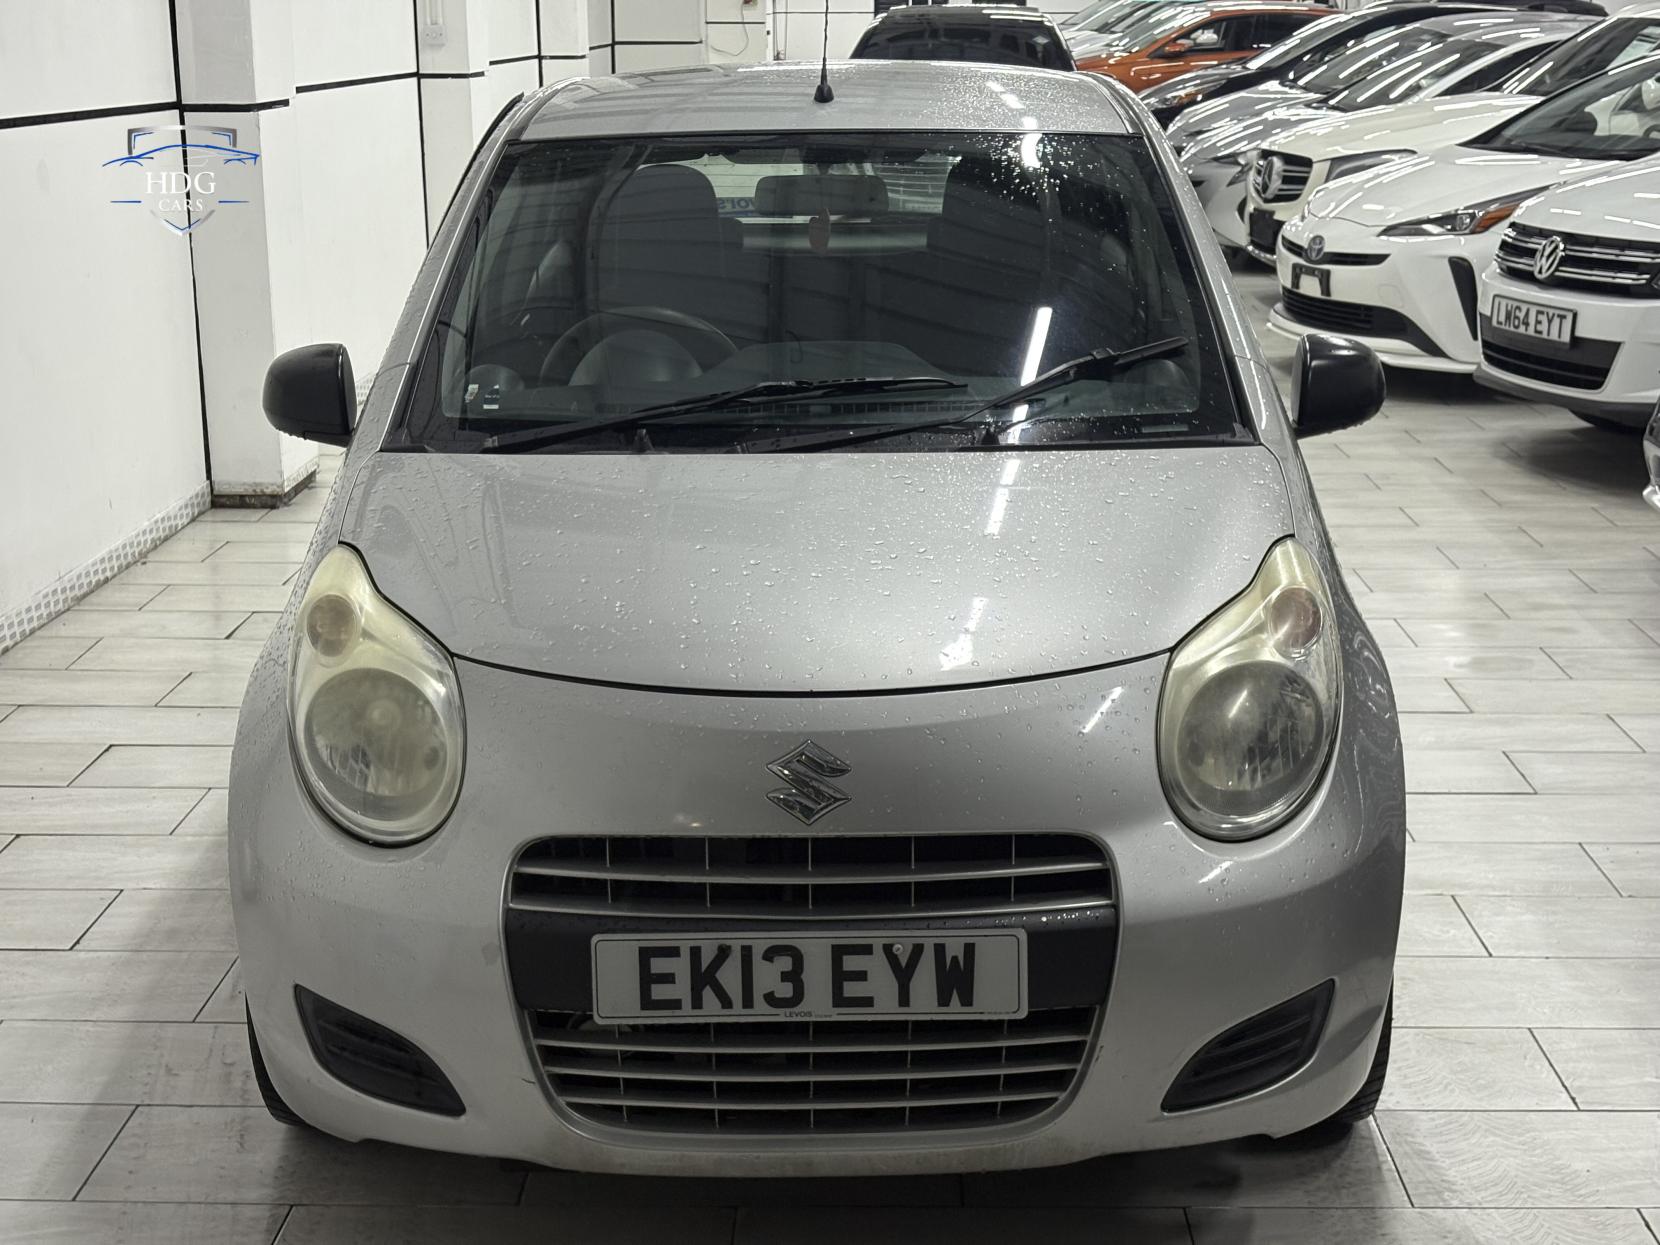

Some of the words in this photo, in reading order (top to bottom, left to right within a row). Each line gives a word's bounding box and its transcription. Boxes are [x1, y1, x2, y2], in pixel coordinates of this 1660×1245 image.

[1496, 300, 1531, 333] LW64
[1534, 308, 1568, 340] EYT
[638, 943, 805, 1011] EK13
[830, 942, 976, 1008] EYW
